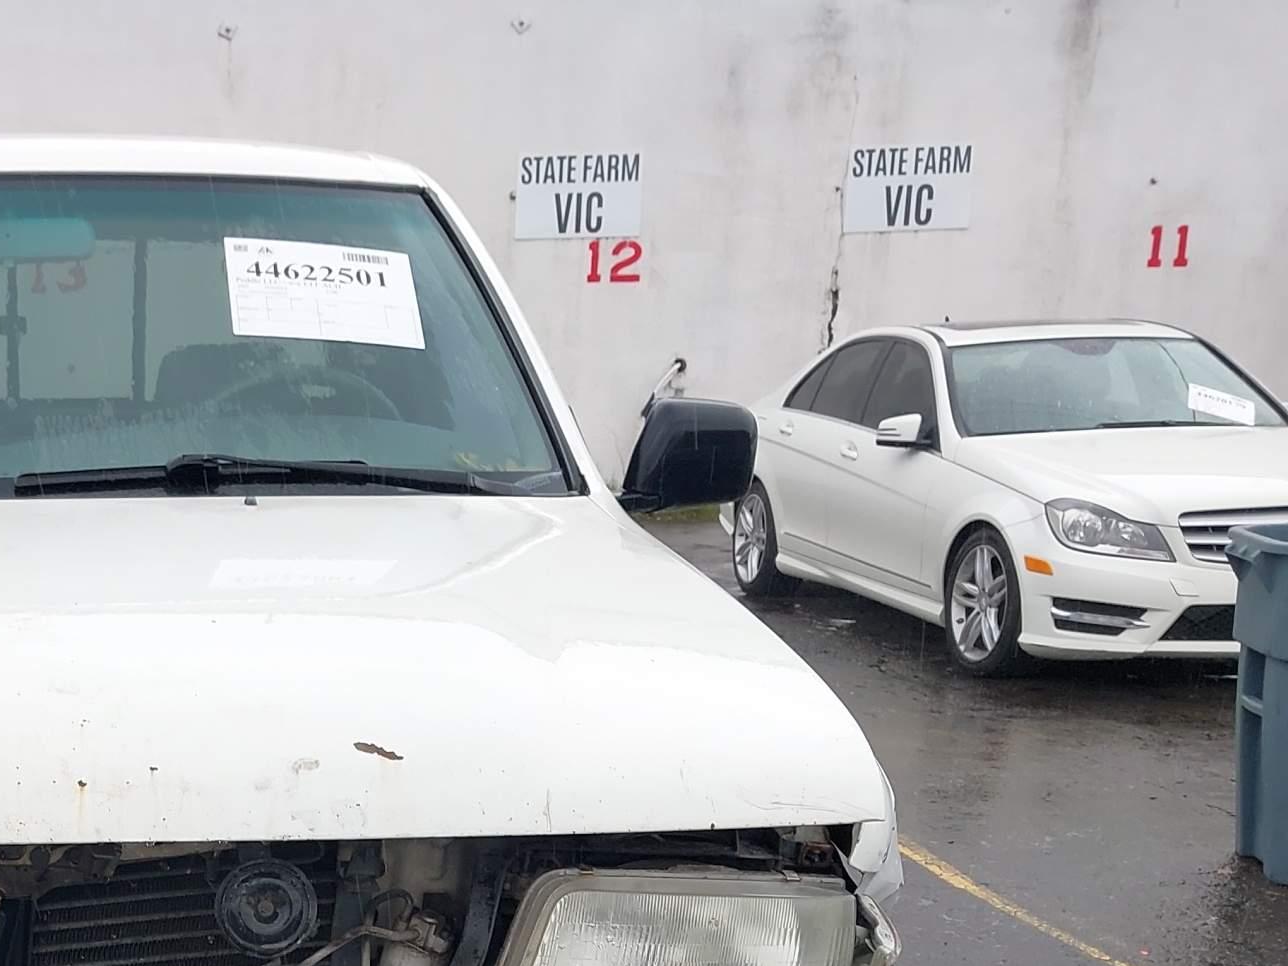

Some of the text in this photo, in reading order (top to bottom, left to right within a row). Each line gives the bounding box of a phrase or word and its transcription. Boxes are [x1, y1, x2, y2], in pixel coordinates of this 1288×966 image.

[521, 153, 640, 184] STATE FARM
[852, 145, 972, 178] STATE FARM
[554, 192, 604, 234] VIC
[885, 183, 934, 227] VIC
[586, 240, 643, 283] 12
[1147, 225, 1189, 267] 11
[246, 260, 389, 288] 44622501
